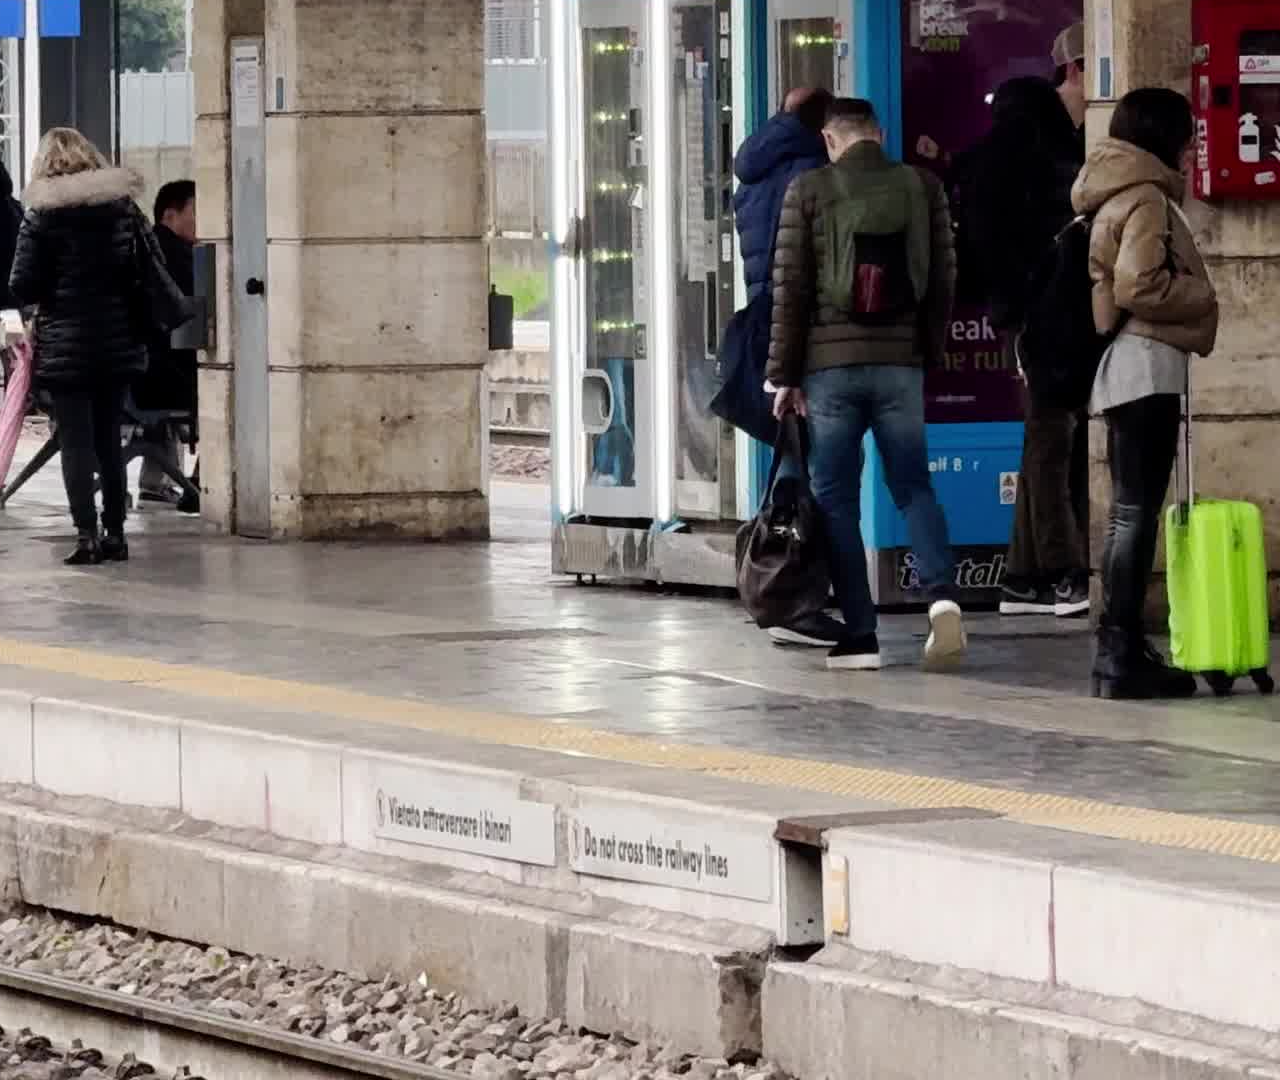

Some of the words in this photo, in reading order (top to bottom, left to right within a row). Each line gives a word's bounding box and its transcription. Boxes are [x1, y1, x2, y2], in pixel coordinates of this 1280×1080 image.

[920, 18, 969, 36] break
[388, 795, 421, 830] Vietato
[422, 806, 478, 839] attraversare
[484, 807, 512, 844] binari
[584, 826, 598, 858] Do
[599, 832, 617, 862] not
[618, 838, 644, 865] cross
[646, 832, 663, 869] the
[665, 839, 703, 882] railway
[704, 842, 729, 879] lines
